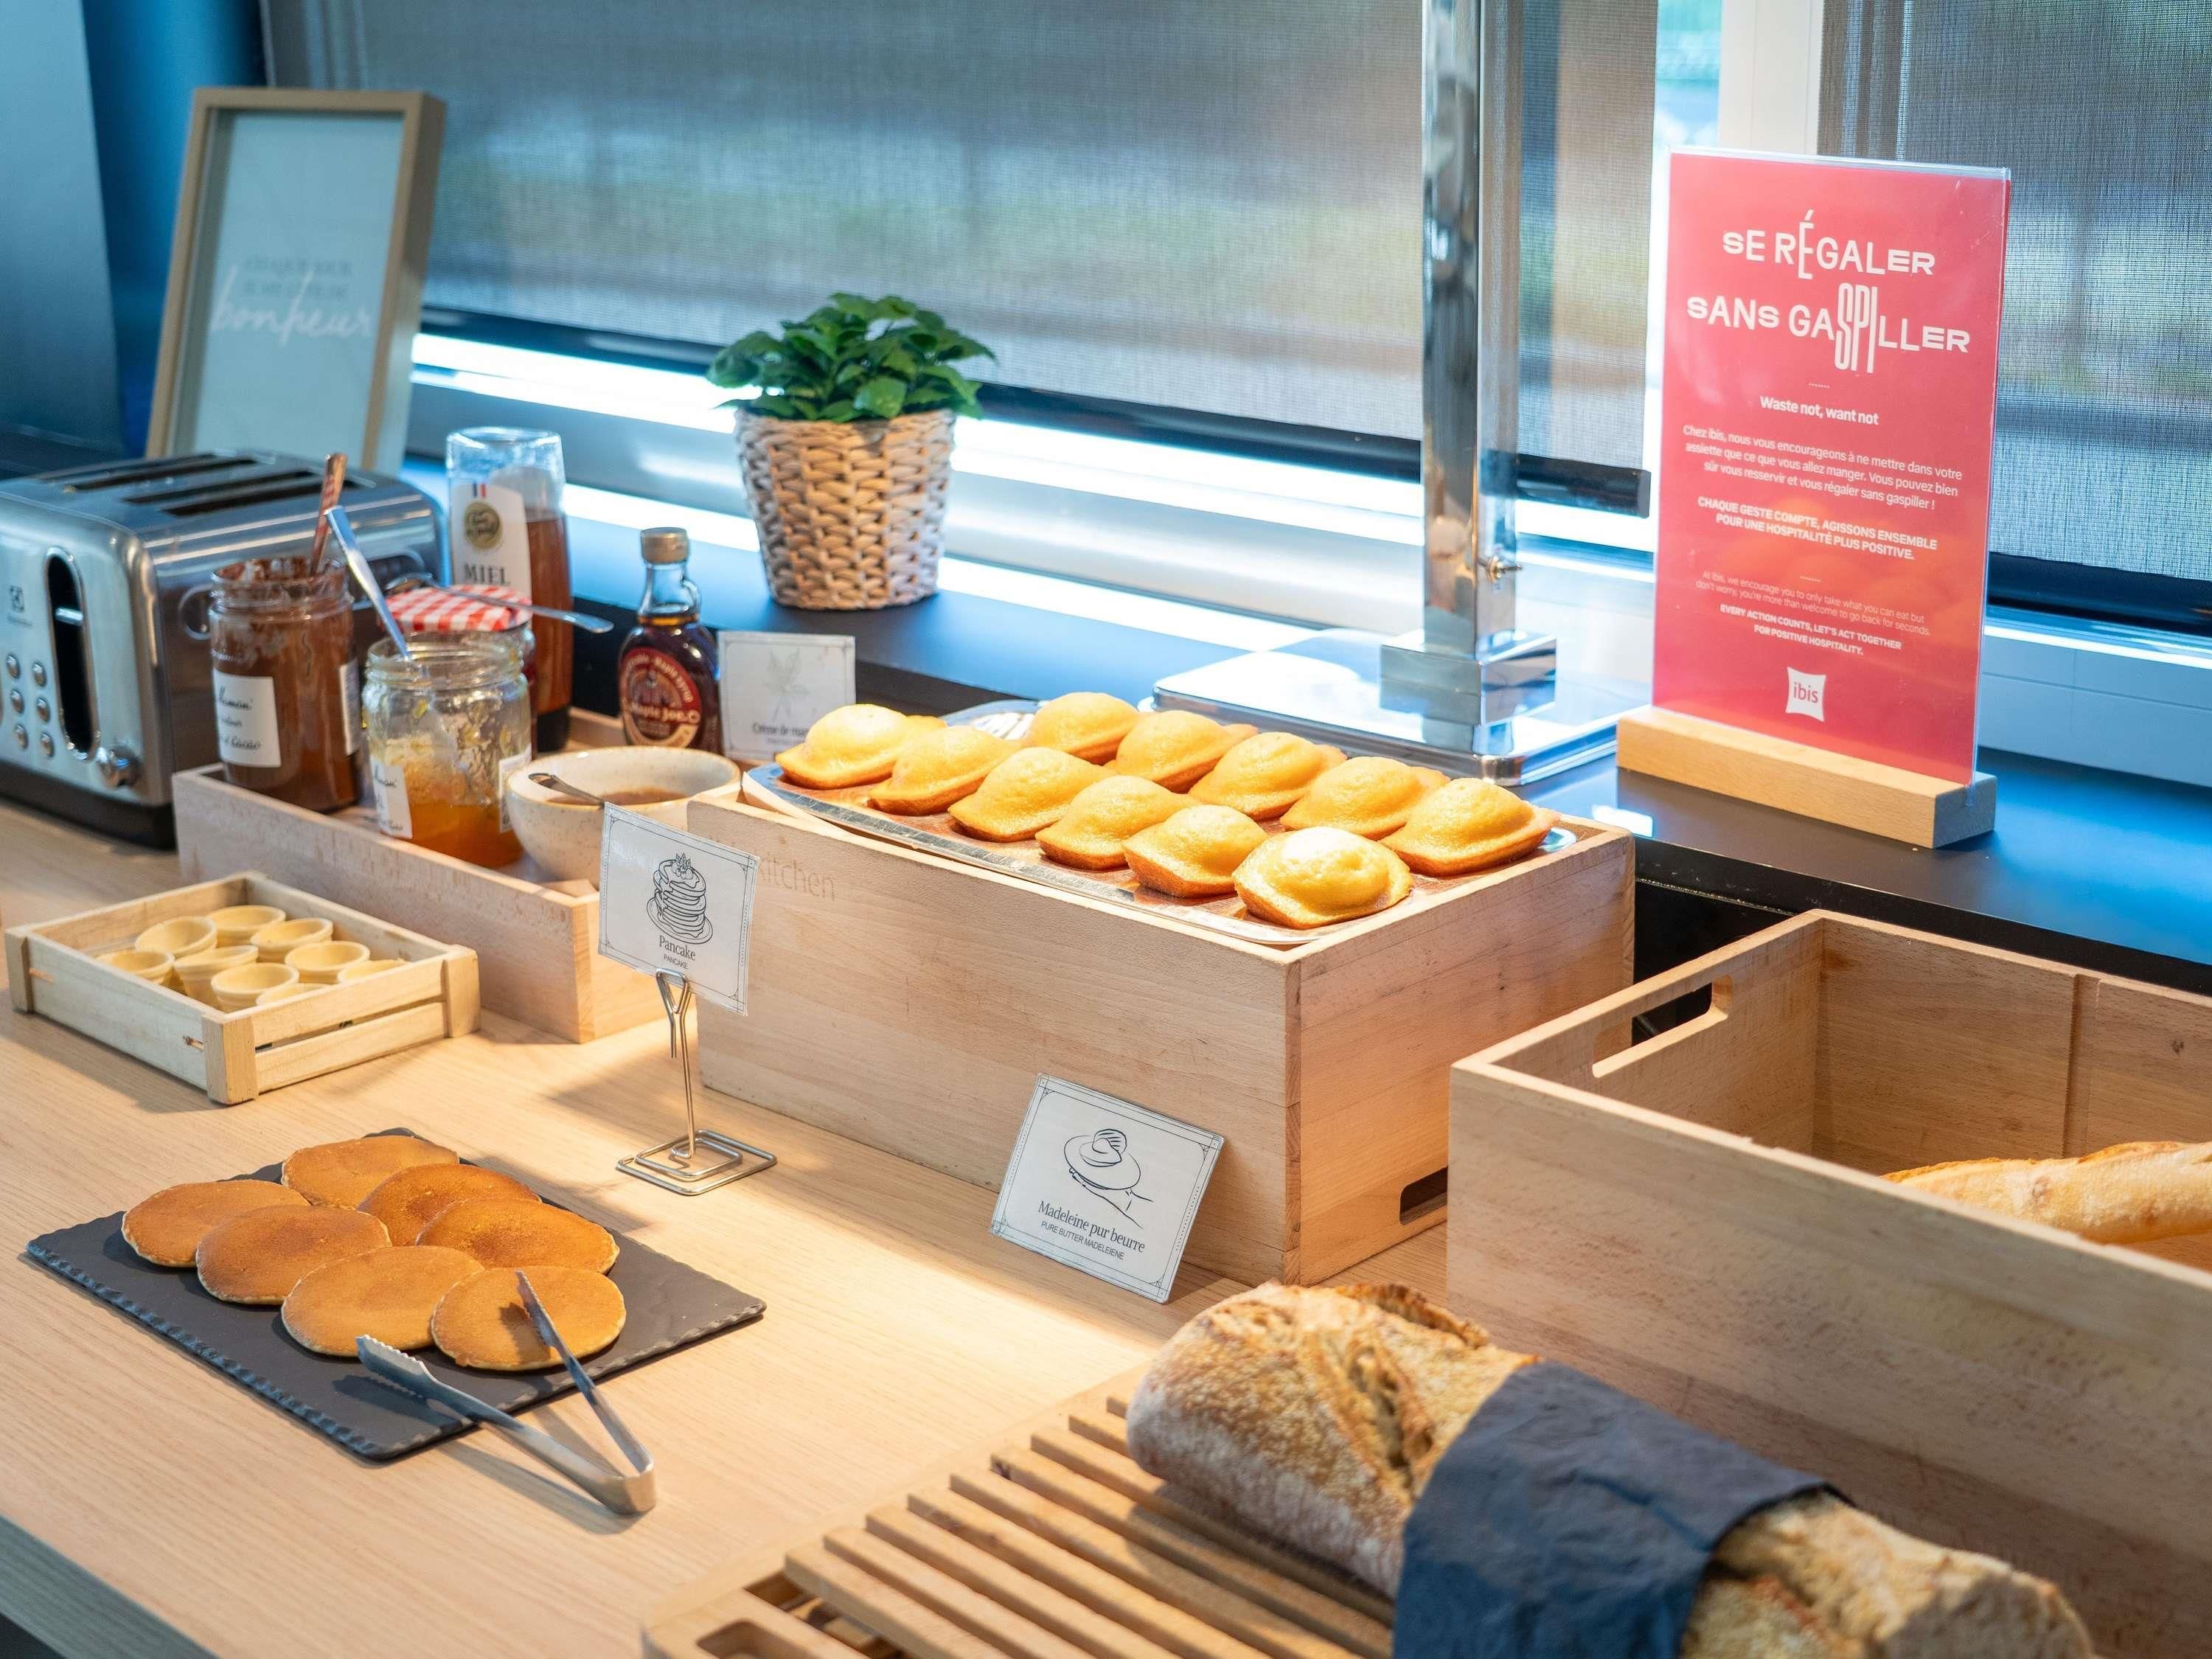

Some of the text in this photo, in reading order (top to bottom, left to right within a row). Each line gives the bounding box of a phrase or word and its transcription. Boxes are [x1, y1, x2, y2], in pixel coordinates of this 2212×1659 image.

[1722, 209, 1935, 279] SE RÉGALER
[1687, 282, 1970, 373] SANS GASPILLER
[1759, 395, 1879, 425] Waste not, want not
[1683, 424, 1963, 481] Chez ibis, nous vous encourageons à ne mettre dans votre
[1685, 442, 1958, 497] assiette que ce que vous allez manger. Vous pouvez bien
[1703, 459, 1719, 473] sûr
[1719, 464, 1743, 477] vous
[1744, 468, 1787, 484] resservir
[1787, 475, 1798, 487] et
[1799, 478, 1823, 491] vous
[1823, 480, 1860, 497] régaler
[1860, 487, 1885, 501] sans
[1886, 493, 1930, 509] gaspiller
[1697, 495, 1938, 550] CHAQUE GESTE COMPTE, AGISSONS ENSEMBLE
[1715, 512, 1915, 560] POUR UNE HOSPITALITÉ PLUS POSITIVE.
[464, 563, 511, 585] MIEL
[1727, 577, 1739, 586] we
[1739, 580, 1780, 595] encourage
[1780, 587, 1795, 598] you
[1796, 590, 1805, 599] to
[1806, 592, 1823, 603] only
[1823, 594, 1842, 607] take
[1843, 599, 1863, 611] what
[1863, 604, 1879, 615] you
[1880, 607, 1894, 618] can
[1896, 610, 1910, 621] eat
[1910, 613, 1926, 625] but
[1762, 594, 1782, 606] more
[1784, 597, 1801, 609] than
[1801, 602, 1838, 618] welcome
[1839, 609, 1848, 619] to
[1848, 612, 1861, 623] go
[1861, 613, 1881, 626] back
[1882, 617, 1893, 628] for
[1719, 603, 1902, 650] EVERY ACTION COUNTS, LET'S ACT TOGETHER
[1753, 624, 1864, 655] FOR POSITIVE HOSPITALITY.
[1793, 681, 1819, 703] ibis
[659, 934, 696, 961] Pancake
[664, 953, 689, 970] PANCAKE
[1037, 1200, 1146, 1253] Madeleine pur beurre
[1040, 1220, 1058, 1234] PURE
[1059, 1227, 1084, 1244] BUTTER
